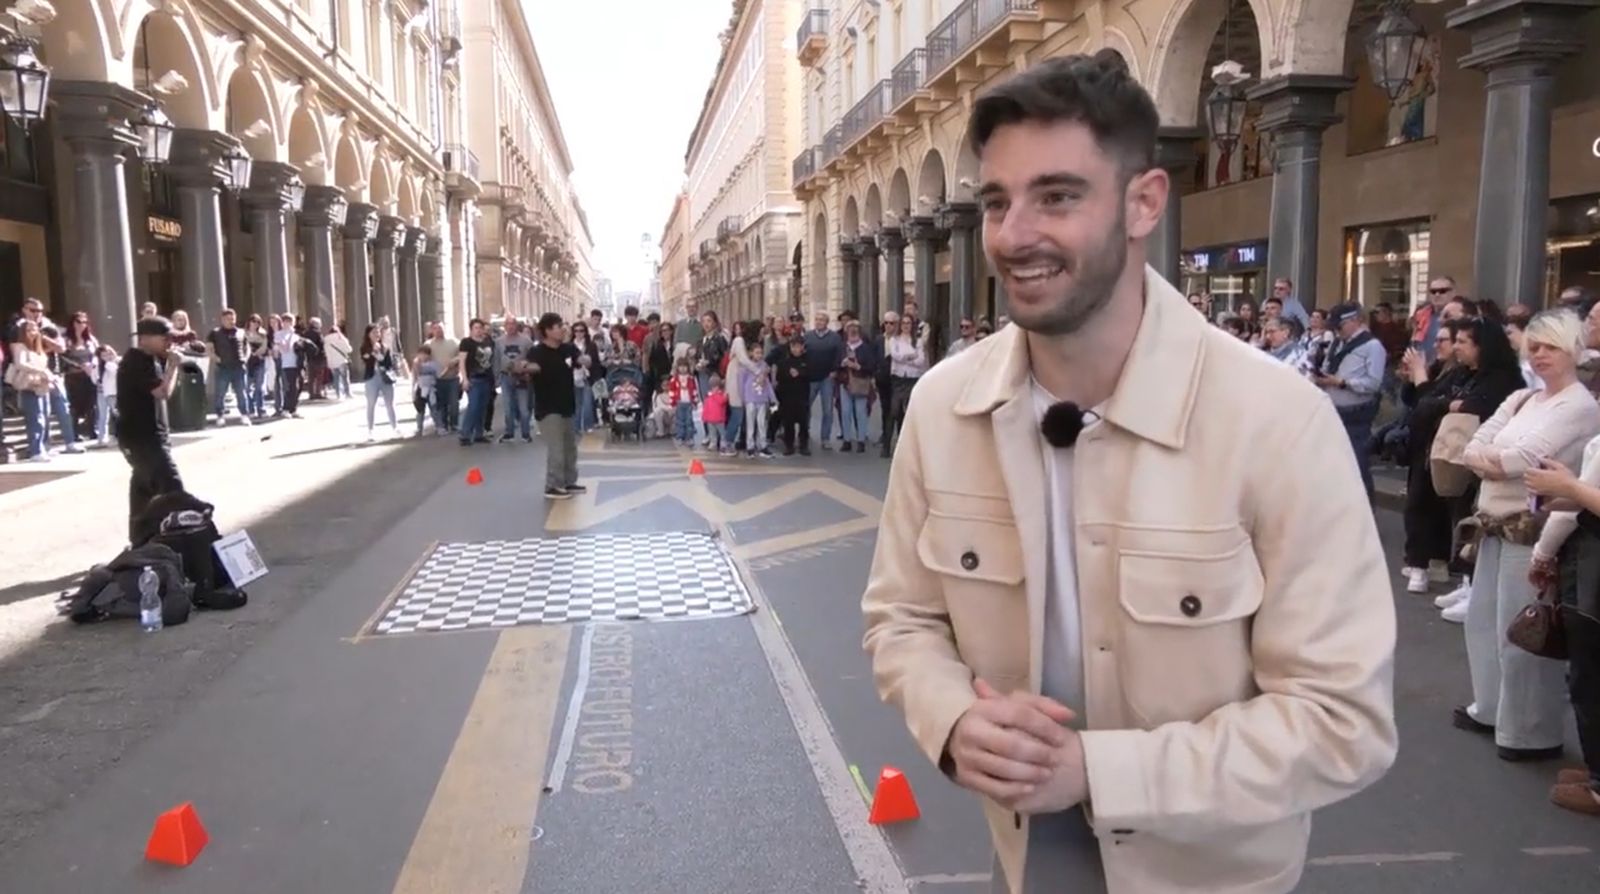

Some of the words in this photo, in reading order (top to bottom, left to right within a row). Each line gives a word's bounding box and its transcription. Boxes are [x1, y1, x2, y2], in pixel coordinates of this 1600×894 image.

[148, 216, 182, 237] FUSARO
[1194, 253, 1209, 267] TIM
[1238, 247, 1255, 262] TIM
[572, 686, 633, 794] FUTURO
